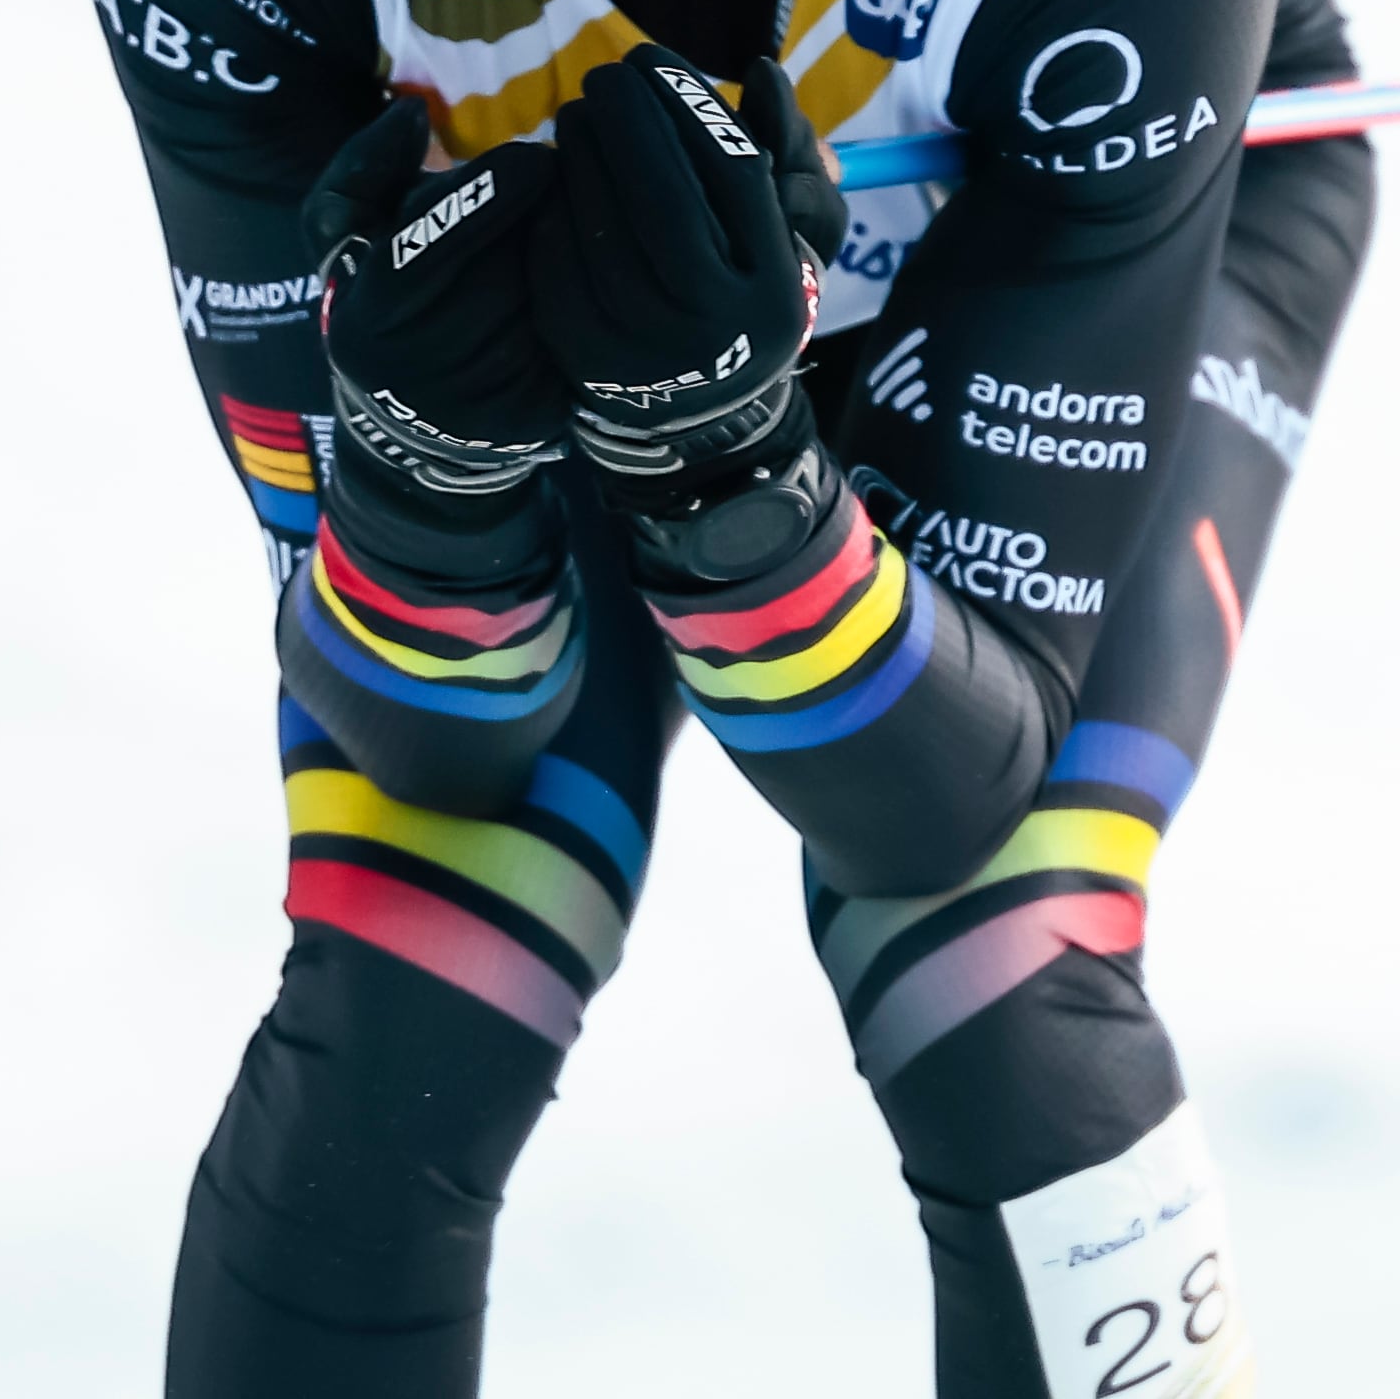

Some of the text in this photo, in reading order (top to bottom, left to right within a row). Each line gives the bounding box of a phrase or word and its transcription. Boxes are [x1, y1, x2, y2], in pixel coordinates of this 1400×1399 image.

[205, 273, 324, 311] GRANDVA
[966, 371, 1147, 427] andorra
[960, 410, 1148, 472] telecom
[916, 510, 1048, 569] AUTO
[1084, 1248, 1229, 1399] 28
